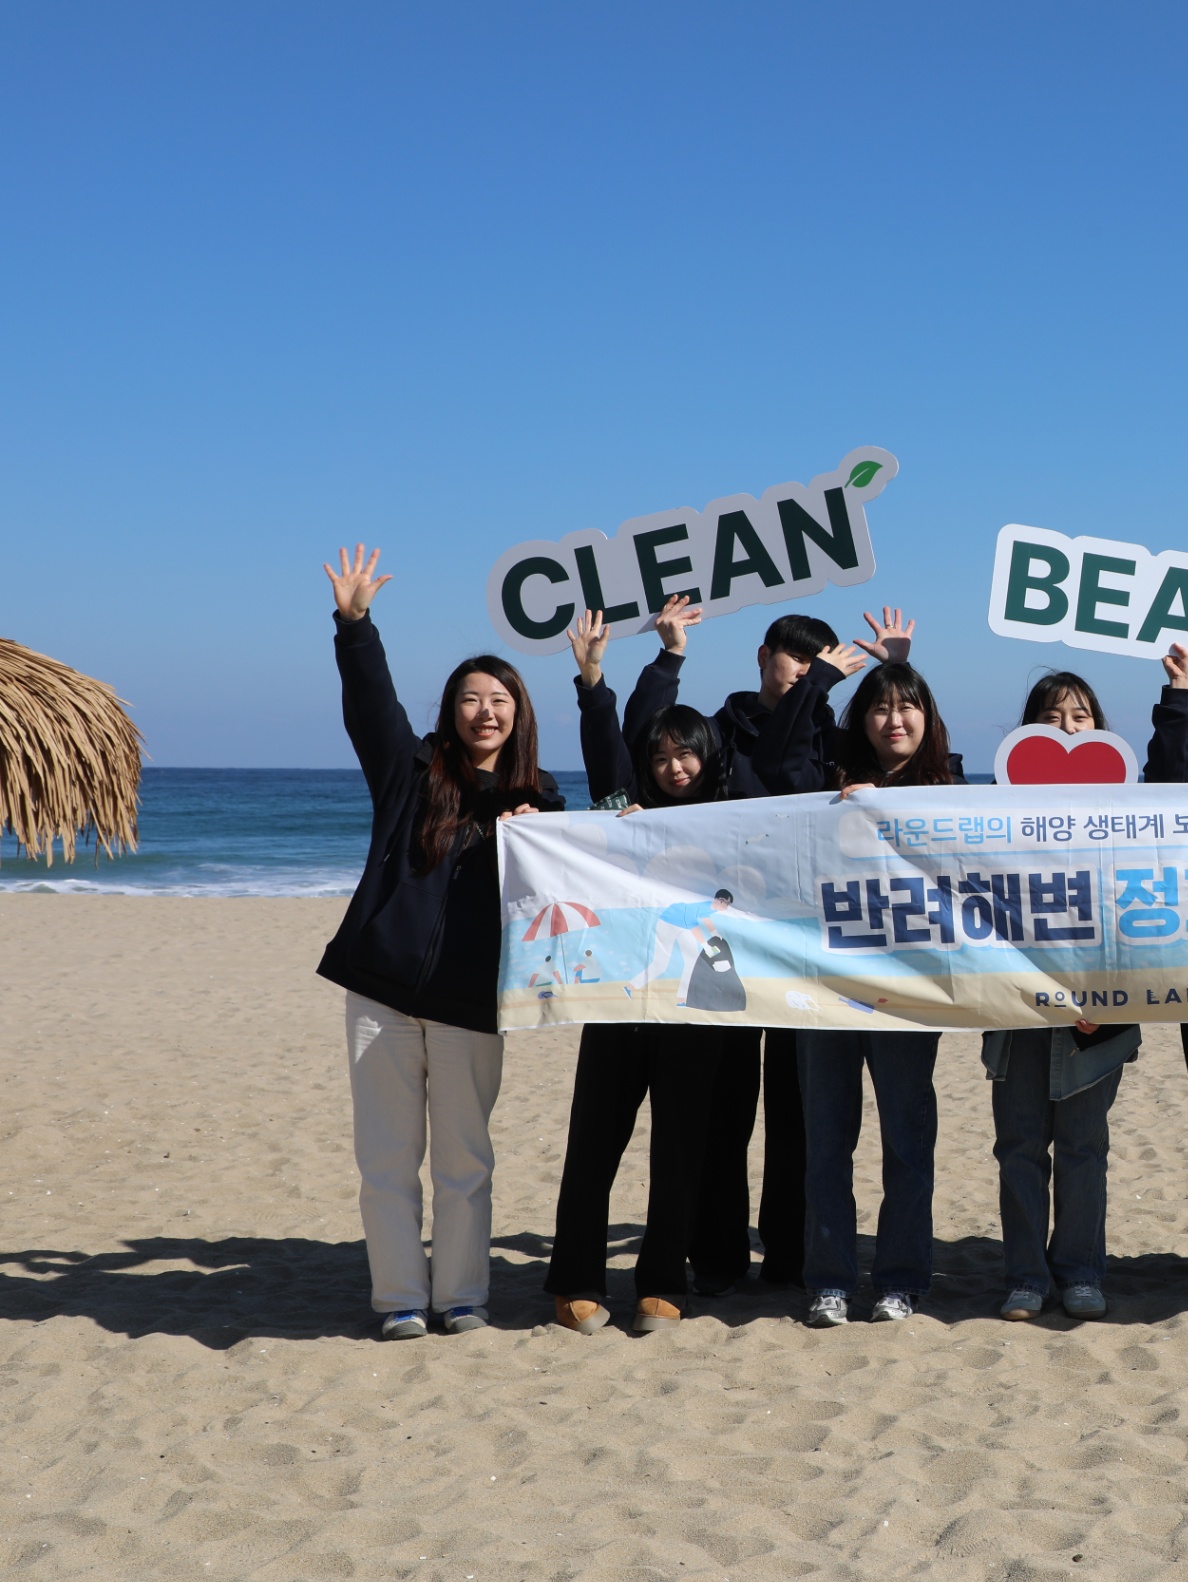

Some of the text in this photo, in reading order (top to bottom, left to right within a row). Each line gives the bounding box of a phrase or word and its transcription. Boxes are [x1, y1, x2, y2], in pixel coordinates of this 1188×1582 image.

[501, 486, 859, 640] CLEAN
[876, 815, 1012, 848] 라운드랩의
[1020, 814, 1076, 843] 해양
[1083, 813, 1165, 841] 생태계
[820, 870, 1095, 949] 반려해변
